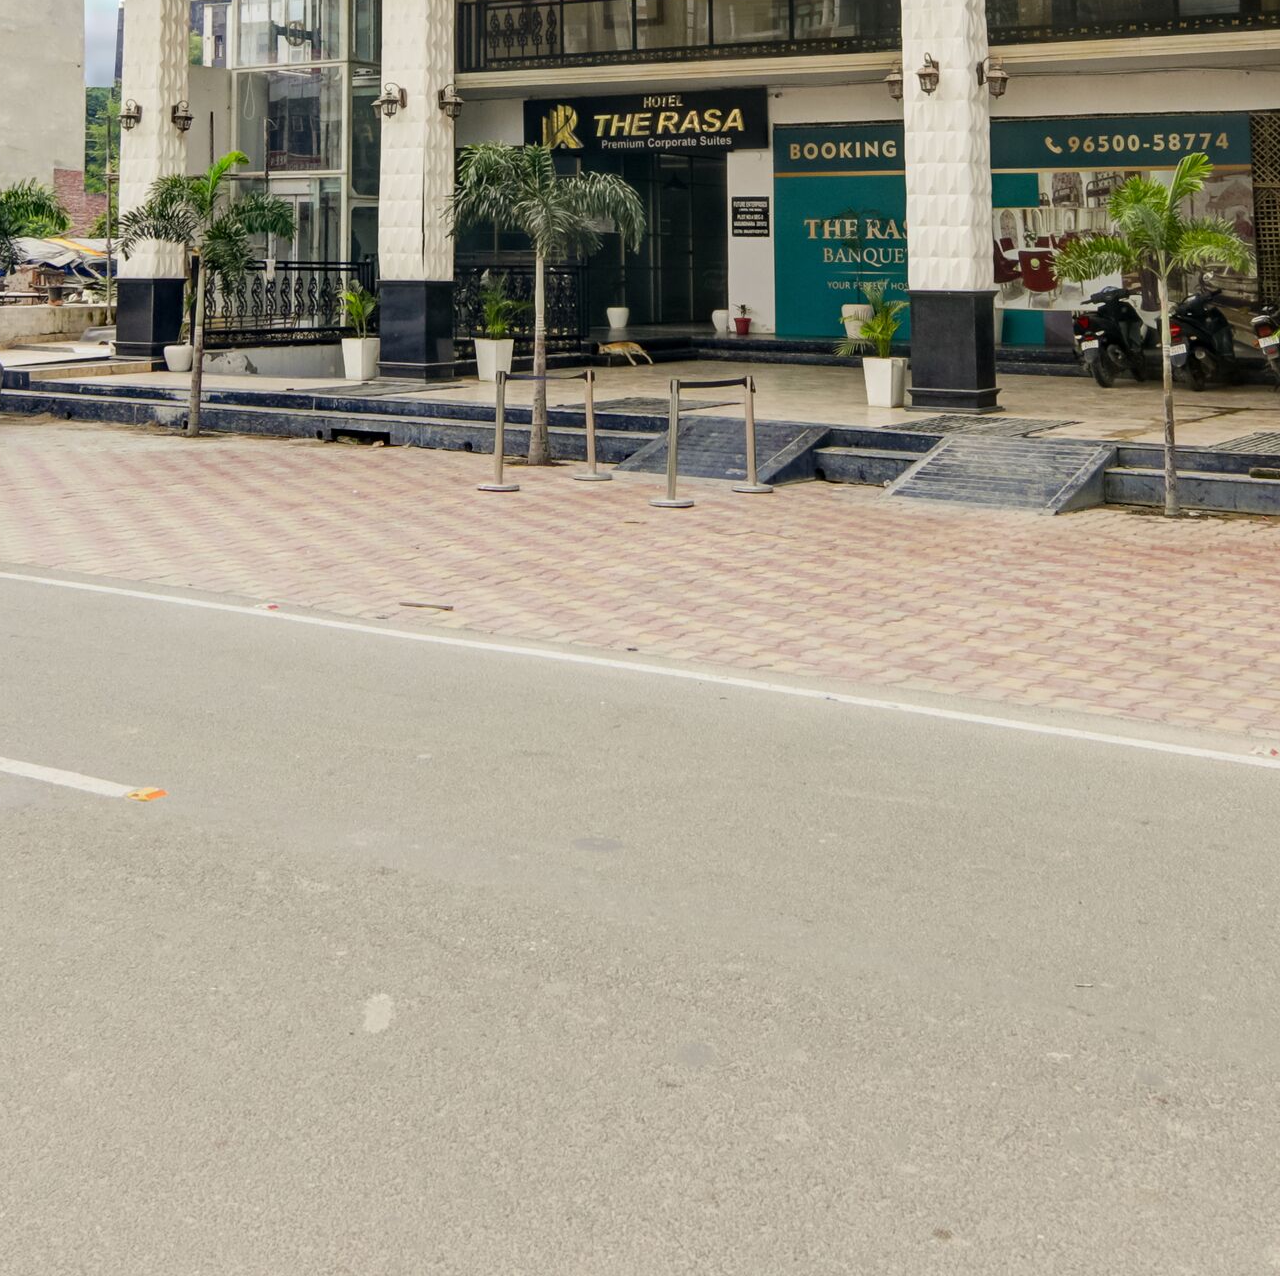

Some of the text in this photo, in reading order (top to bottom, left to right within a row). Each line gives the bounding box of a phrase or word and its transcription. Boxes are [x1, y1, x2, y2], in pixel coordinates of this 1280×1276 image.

[643, 94, 683, 108] HOTEL
[593, 108, 745, 137] THE RASA
[601, 136, 732, 149] Premium Corporate Suites
[789, 140, 897, 160] BOOKING
[1068, 132, 1230, 154] 96500-58774
[804, 219, 858, 239] THE
[823, 248, 908, 267] BANQUE
[827, 281, 851, 289] YOUR
